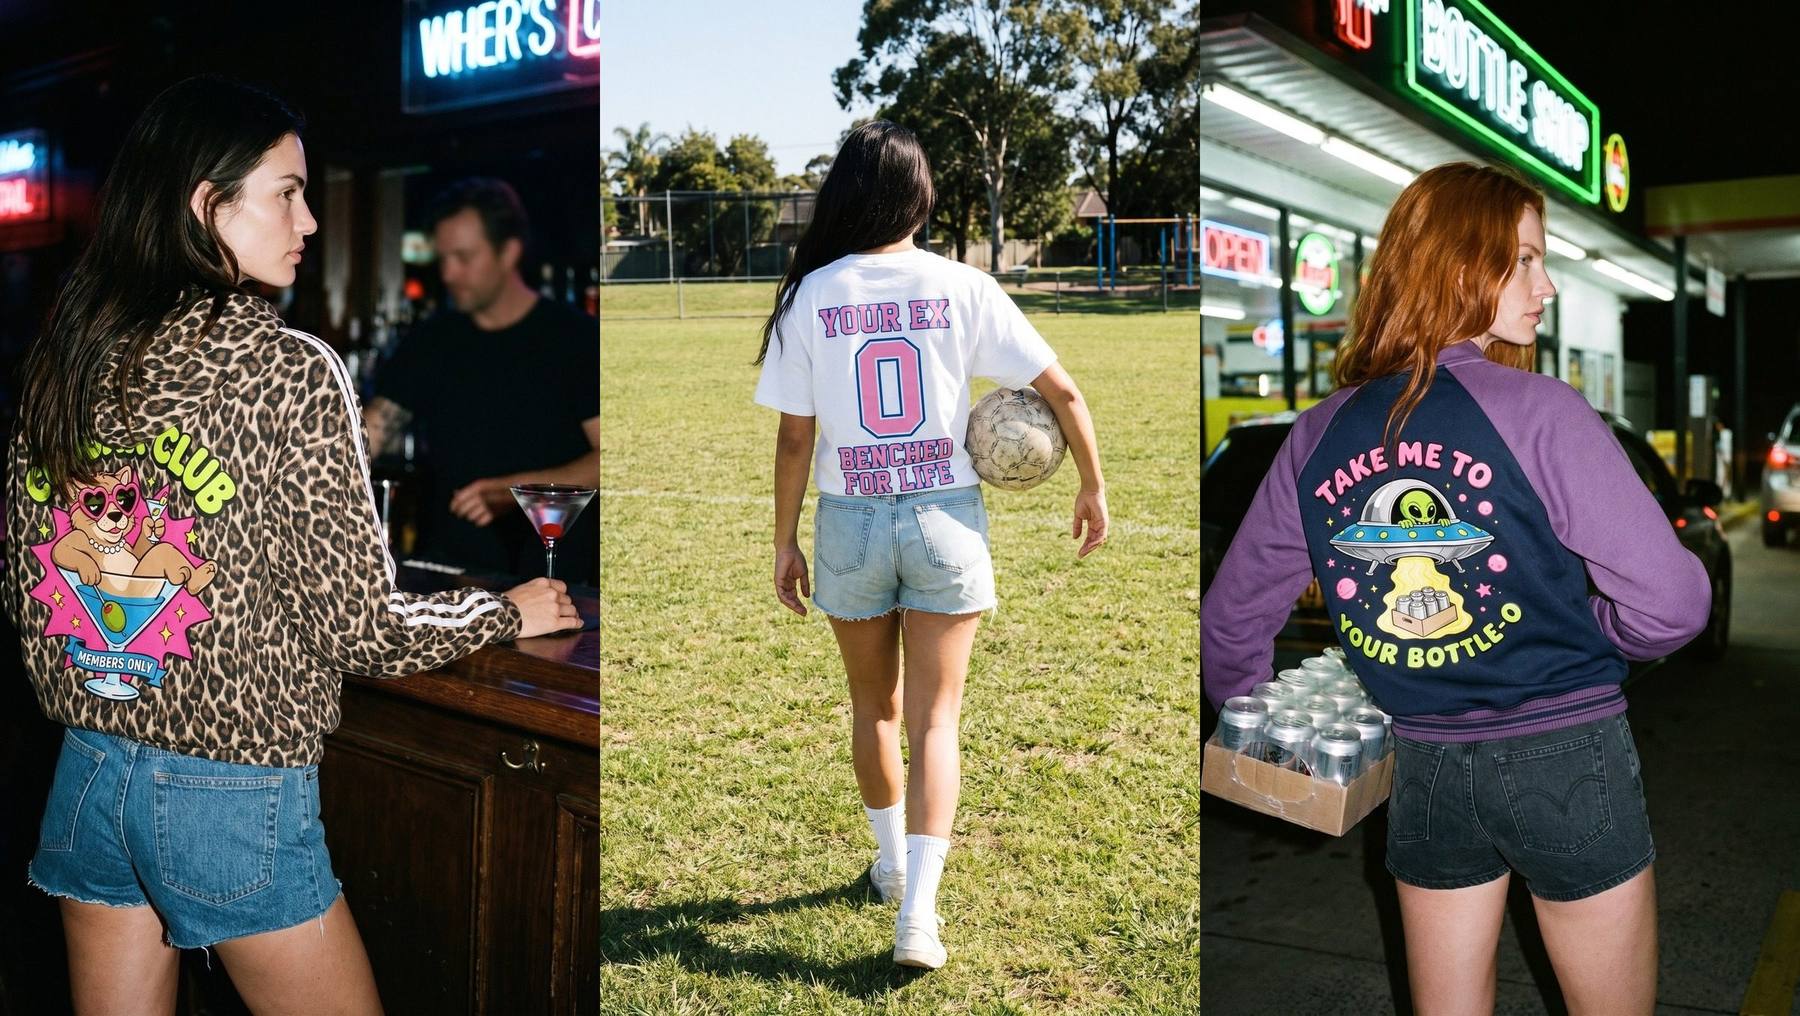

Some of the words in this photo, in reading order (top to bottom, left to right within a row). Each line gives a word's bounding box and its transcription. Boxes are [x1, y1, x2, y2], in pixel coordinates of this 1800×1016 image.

[1422, 0, 1528, 134] BOTTLE
[1532, 80, 1590, 171] SHOP
[1205, 226, 1264, 275] OPEN
[818, 302, 902, 338] YOUR
[908, 299, 950, 330] EX
[153, 426, 237, 515] CLUB
[838, 437, 954, 471] BENCHED
[844, 471, 893, 495] FOR
[898, 460, 954, 492] LIFE
[1315, 446, 1389, 505] TAKE
[1398, 441, 1443, 469] ME
[1452, 450, 1493, 489] TO
[1340, 613, 1399, 665] YOUR
[1407, 603, 1522, 669] BOTTLE-O
[77, 650, 125, 669] MEMBERS
[127, 658, 153, 673] ONLY
